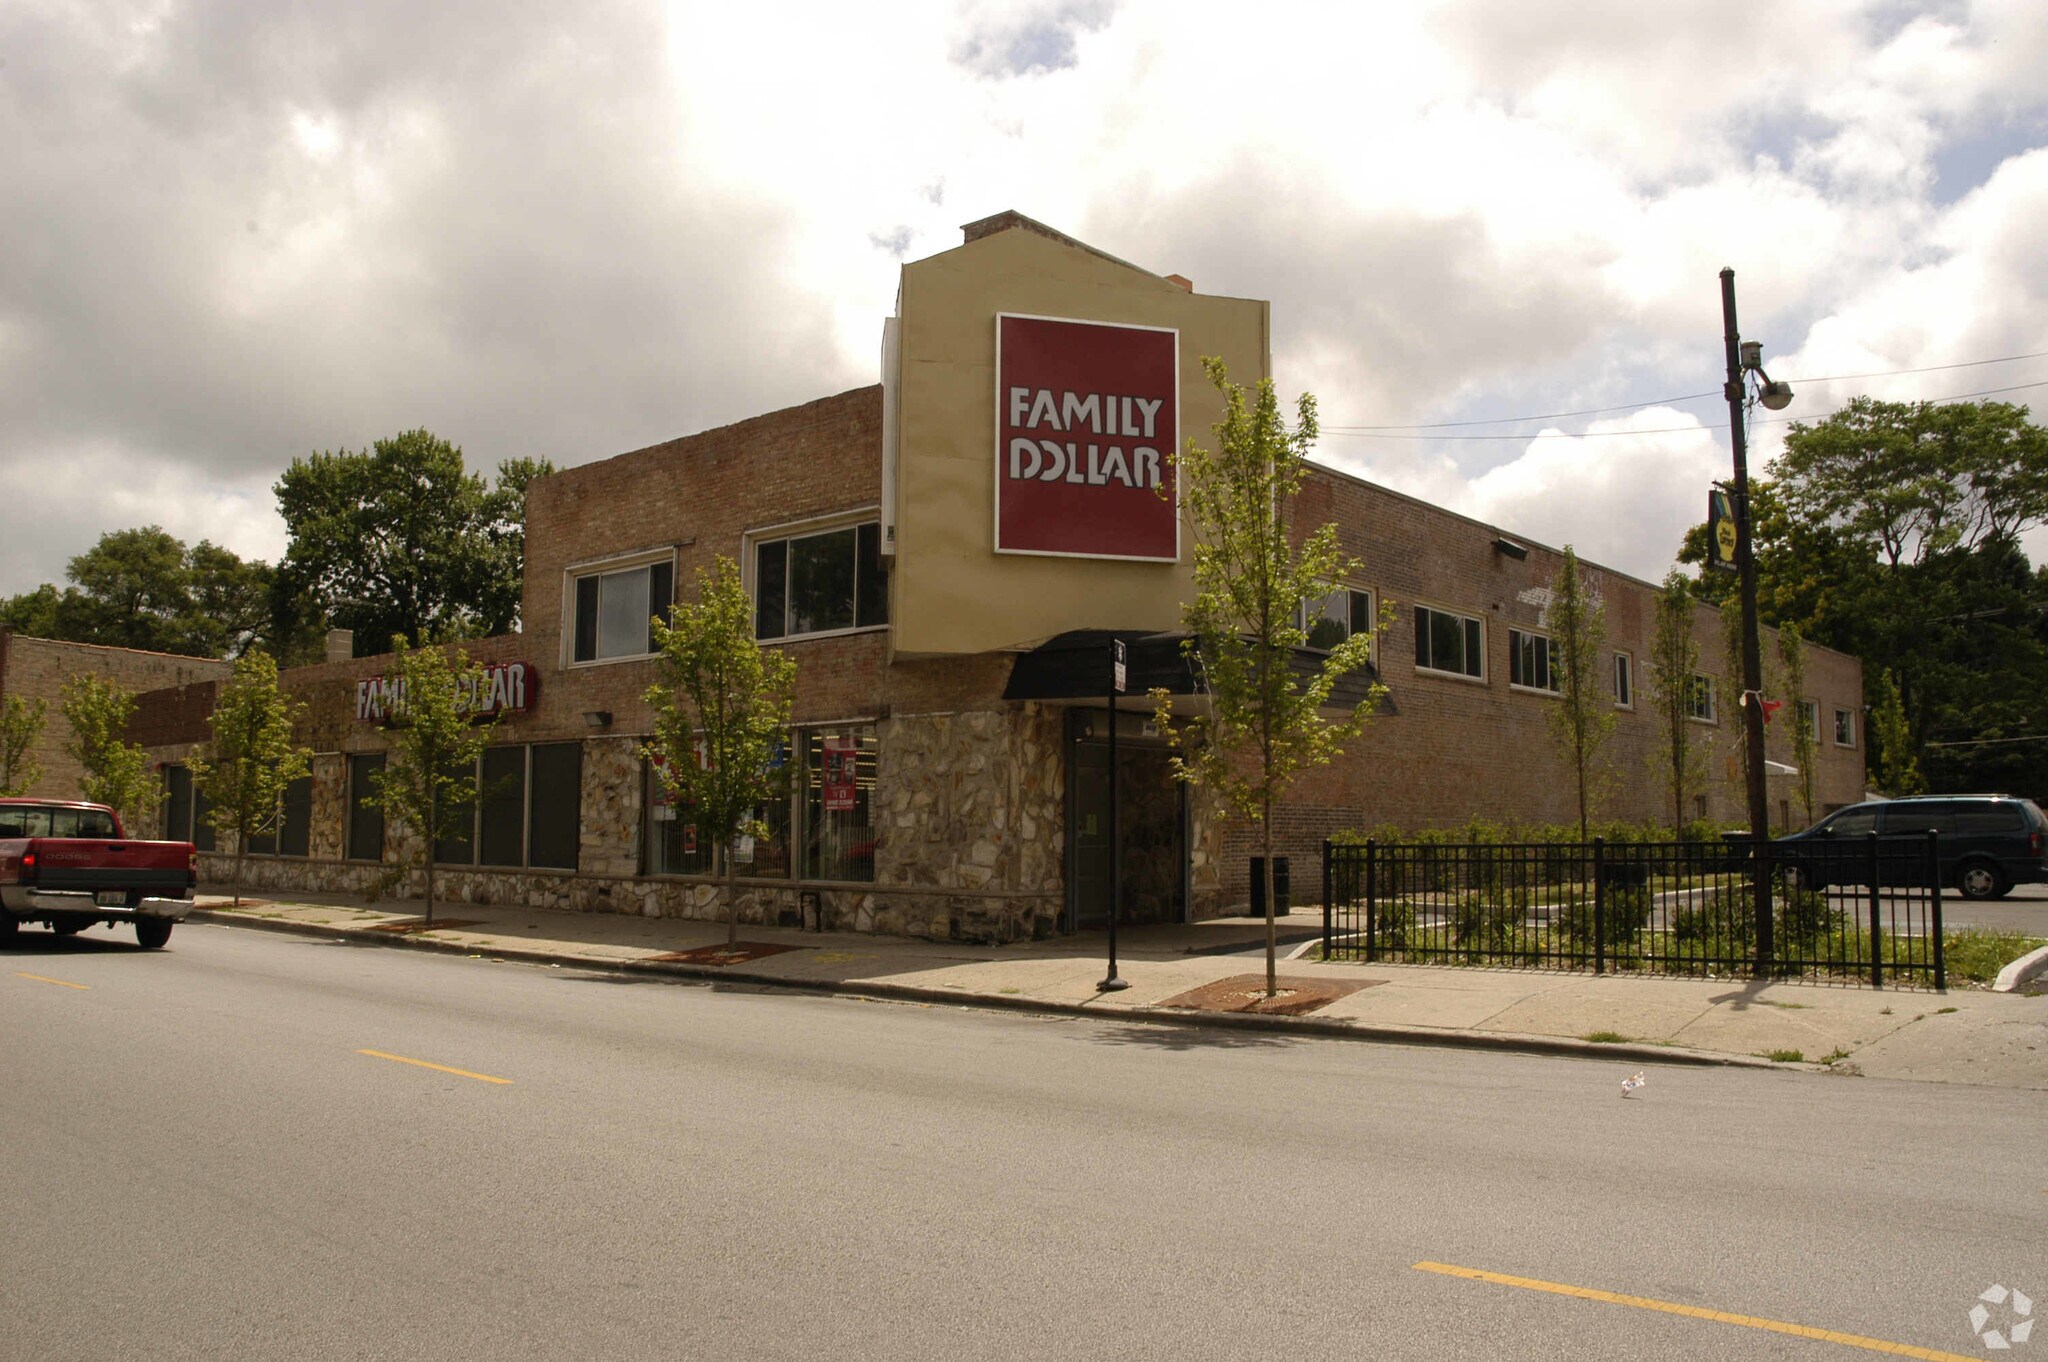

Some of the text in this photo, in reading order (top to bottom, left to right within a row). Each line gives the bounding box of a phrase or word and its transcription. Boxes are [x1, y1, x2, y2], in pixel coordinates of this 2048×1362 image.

[1010, 386, 1164, 438] FAMILY
[1009, 437, 1161, 489] DOLLAR
[357, 674, 416, 720] FAMI
[45, 853, 92, 861] DODGE
